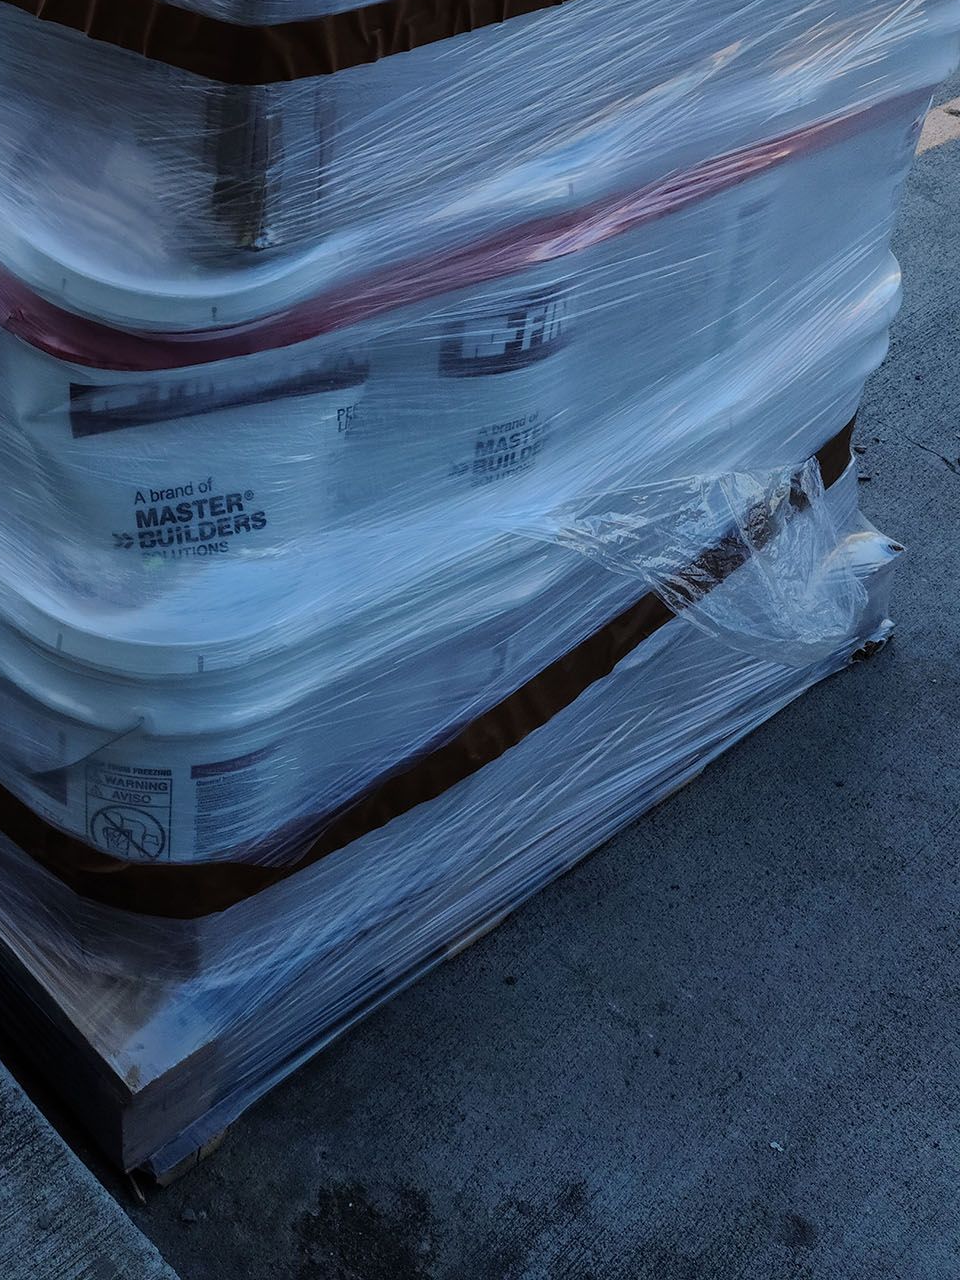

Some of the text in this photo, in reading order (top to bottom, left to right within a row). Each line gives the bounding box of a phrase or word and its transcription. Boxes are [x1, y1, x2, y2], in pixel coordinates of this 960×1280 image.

[492, 416, 526, 435] brand
[134, 476, 213, 505] A brand of
[137, 510, 268, 549] BUILDERS
[104, 774, 168, 792] WARNING
[112, 790, 152, 804] AVISO
